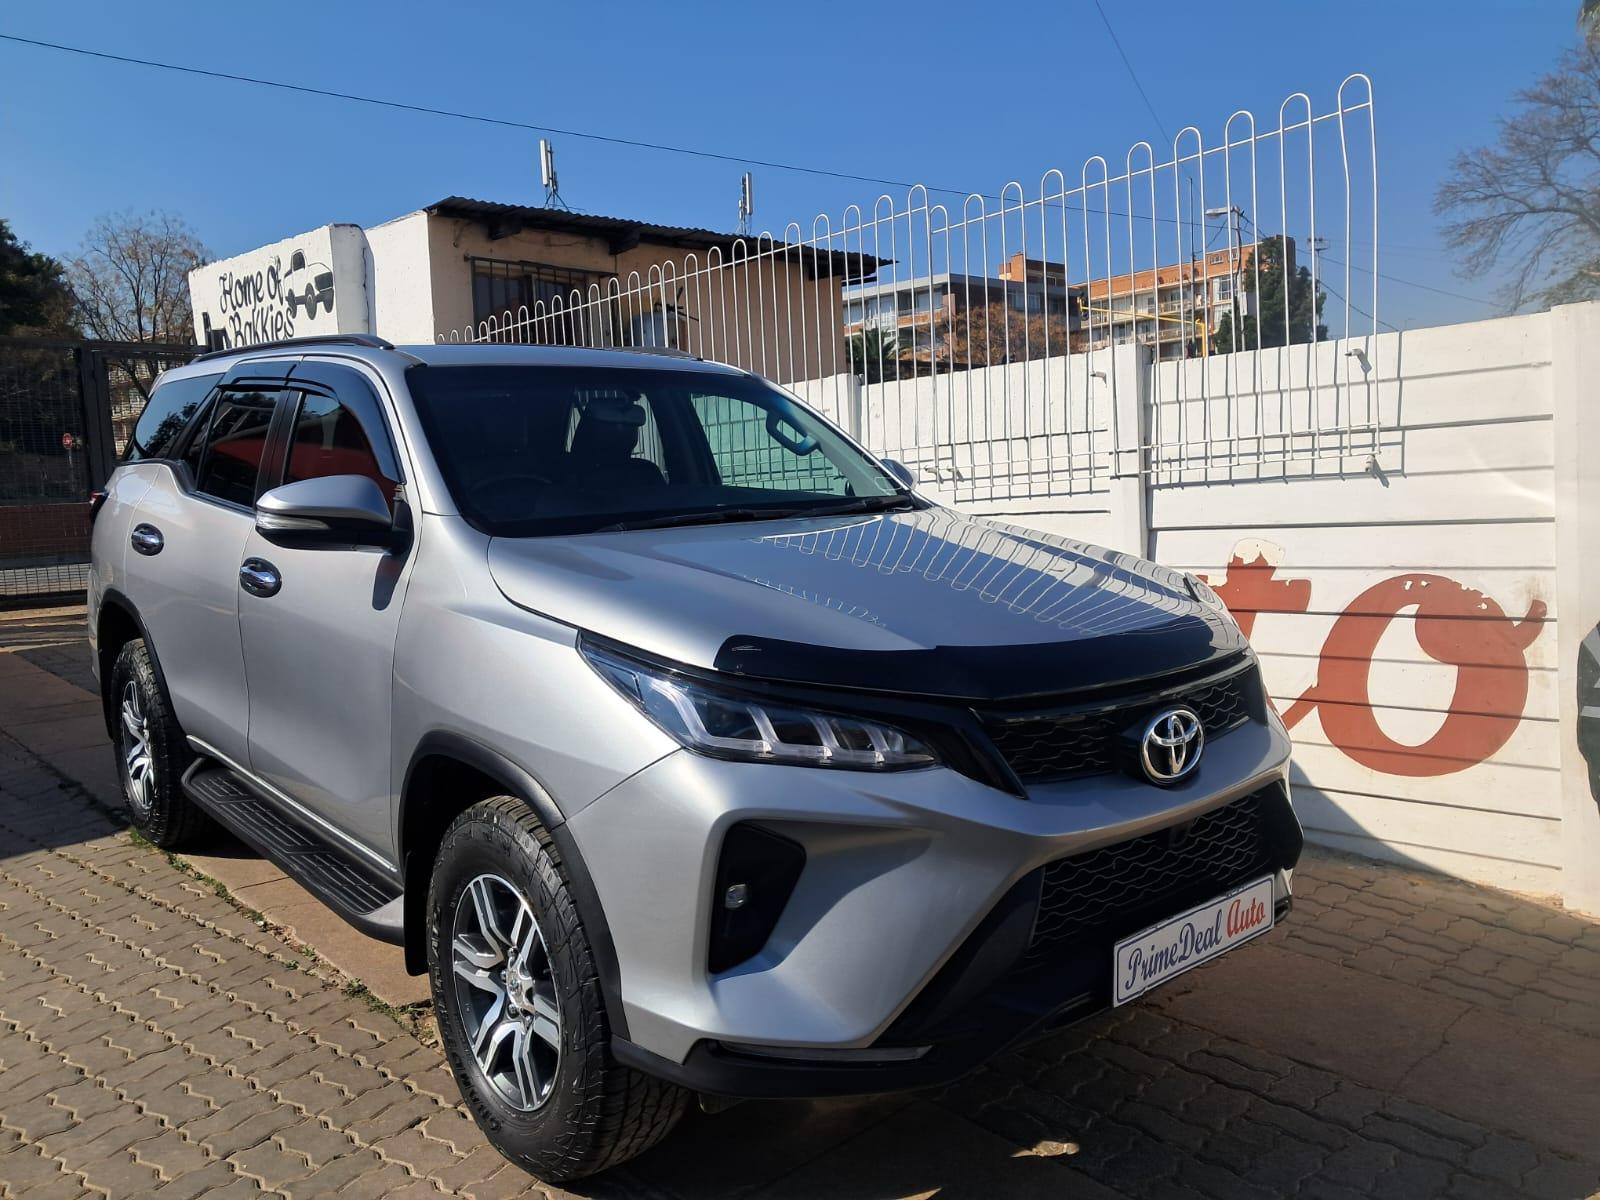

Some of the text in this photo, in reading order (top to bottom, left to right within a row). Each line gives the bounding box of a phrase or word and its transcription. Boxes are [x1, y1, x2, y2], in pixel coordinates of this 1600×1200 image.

[219, 271, 265, 314] Home
[1124, 898, 1266, 991] PrimeDeal Auto
